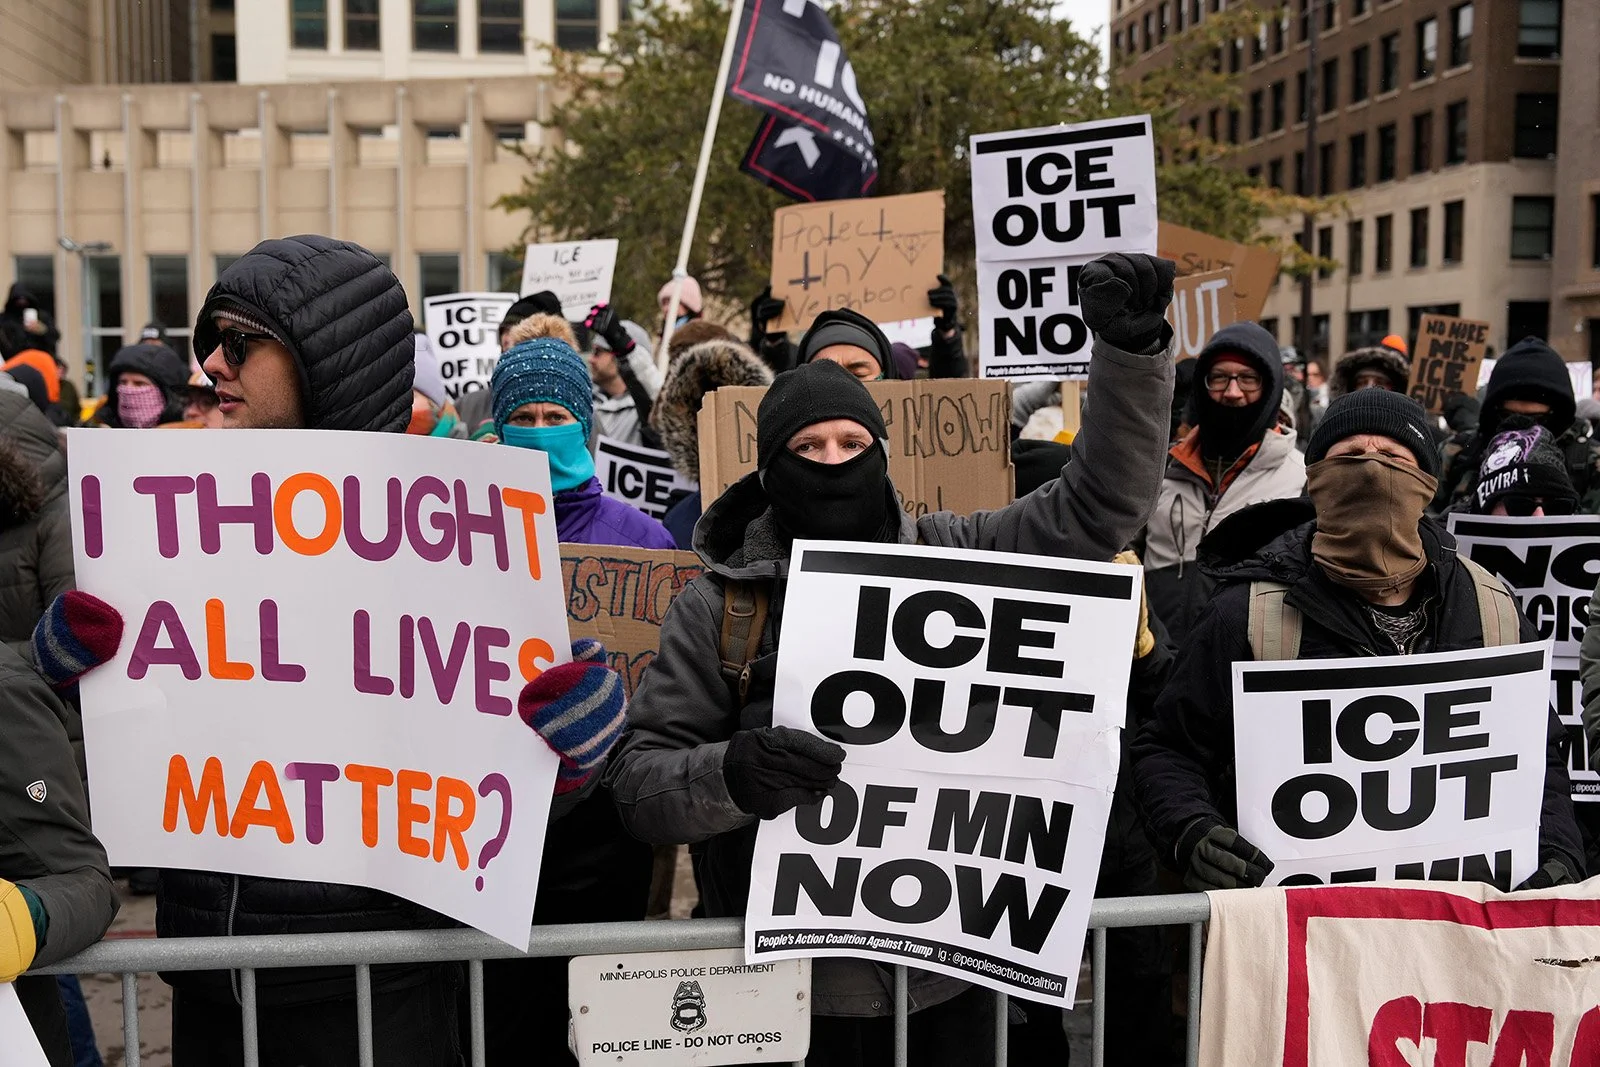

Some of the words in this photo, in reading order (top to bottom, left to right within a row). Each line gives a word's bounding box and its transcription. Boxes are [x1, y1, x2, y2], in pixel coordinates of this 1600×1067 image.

[763, 72, 796, 94] NO
[799, 85, 863, 131] HUMAN
[1006, 146, 1115, 198] ICE
[779, 208, 893, 252] Protect
[992, 194, 1136, 247] OUT
[553, 246, 581, 266] ICE
[997, 267, 1055, 310] OF
[446, 306, 500, 326] ICE
[994, 313, 1095, 357] NO
[1426, 320, 1446, 336] NO
[1448, 322, 1489, 344] MORE
[441, 359, 469, 379] OF
[476, 358, 495, 376] M
[1429, 338, 1476, 362] MR.
[444, 381, 492, 401] NO
[1417, 358, 1466, 390] ICE
[607, 461, 675, 508] ICE
[1477, 468, 1518, 508] ELVIRA
[81, 475, 103, 559] I
[133, 472, 546, 581] THOUGHT
[127, 598, 306, 682] ALL
[853, 585, 1071, 678] ICE
[810, 670, 1096, 759] OUT
[1301, 686, 1492, 764] ICE
[1271, 754, 1518, 840] OUT
[162, 754, 512, 892] MATTER?
[794, 779, 918, 849] OF
[928, 787, 1074, 874] MN
[771, 853, 1071, 954] NOW
[600, 970, 667, 981] MINNEAPOLIS
[671, 967, 706, 978] POLICE
[710, 963, 775, 976] DEPARTMENT
[757, 934, 795, 948] People's
[794, 933, 825, 945] Action
[825, 933, 867, 945] Coalition
[865, 935, 902, 950] Against
[904, 940, 933, 958] Trump
[952, 952, 1063, 992] @peoplesactioncoalition
[592, 1040, 639, 1054] POLICE
[644, 1038, 672, 1050] LINE
[684, 1037, 704, 1048] DO
[707, 1034, 734, 1047] NOT
[737, 1031, 782, 1044] CROSS
